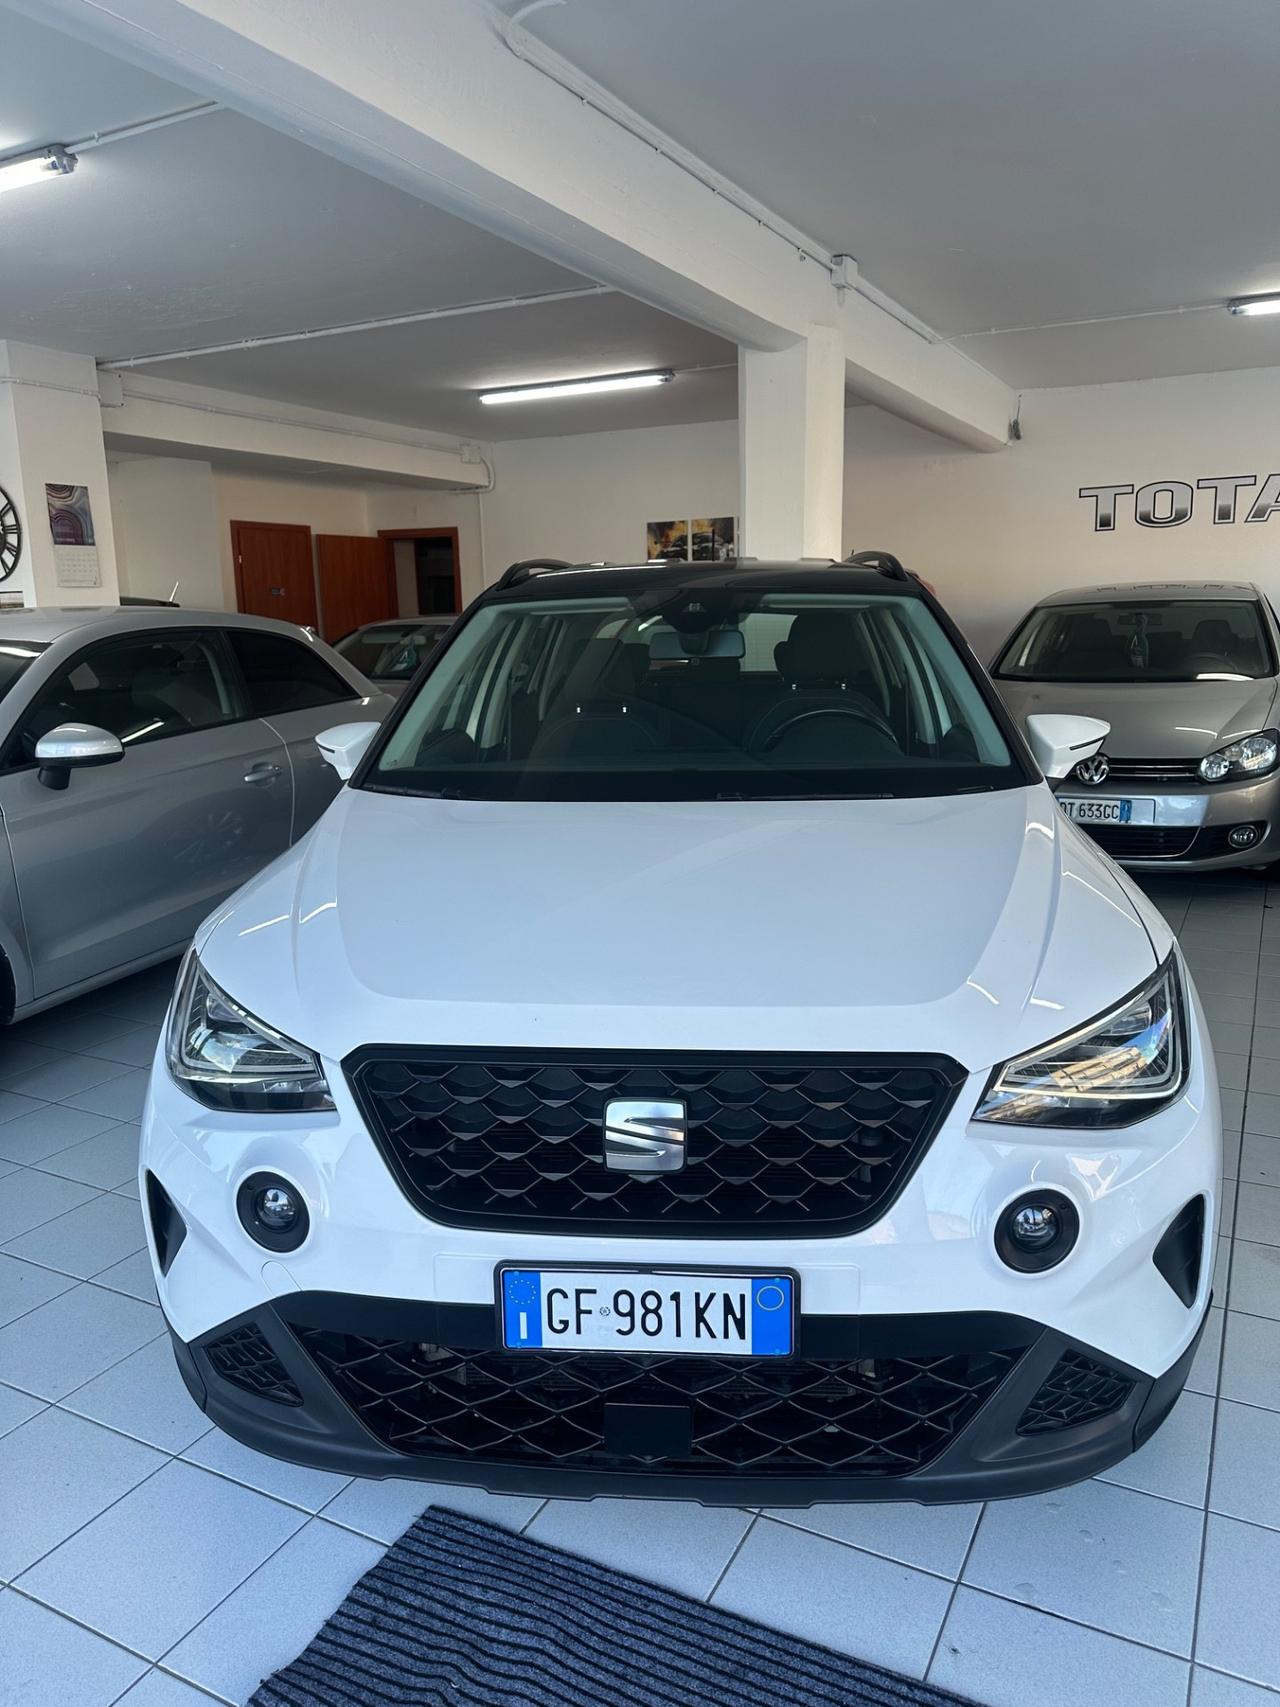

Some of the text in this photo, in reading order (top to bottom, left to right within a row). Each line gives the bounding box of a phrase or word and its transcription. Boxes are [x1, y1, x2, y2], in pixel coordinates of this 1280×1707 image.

[1078, 803, 1119, 819] 633GC
[546, 1287, 598, 1336] GF
[612, 1289, 747, 1341] 981KN
